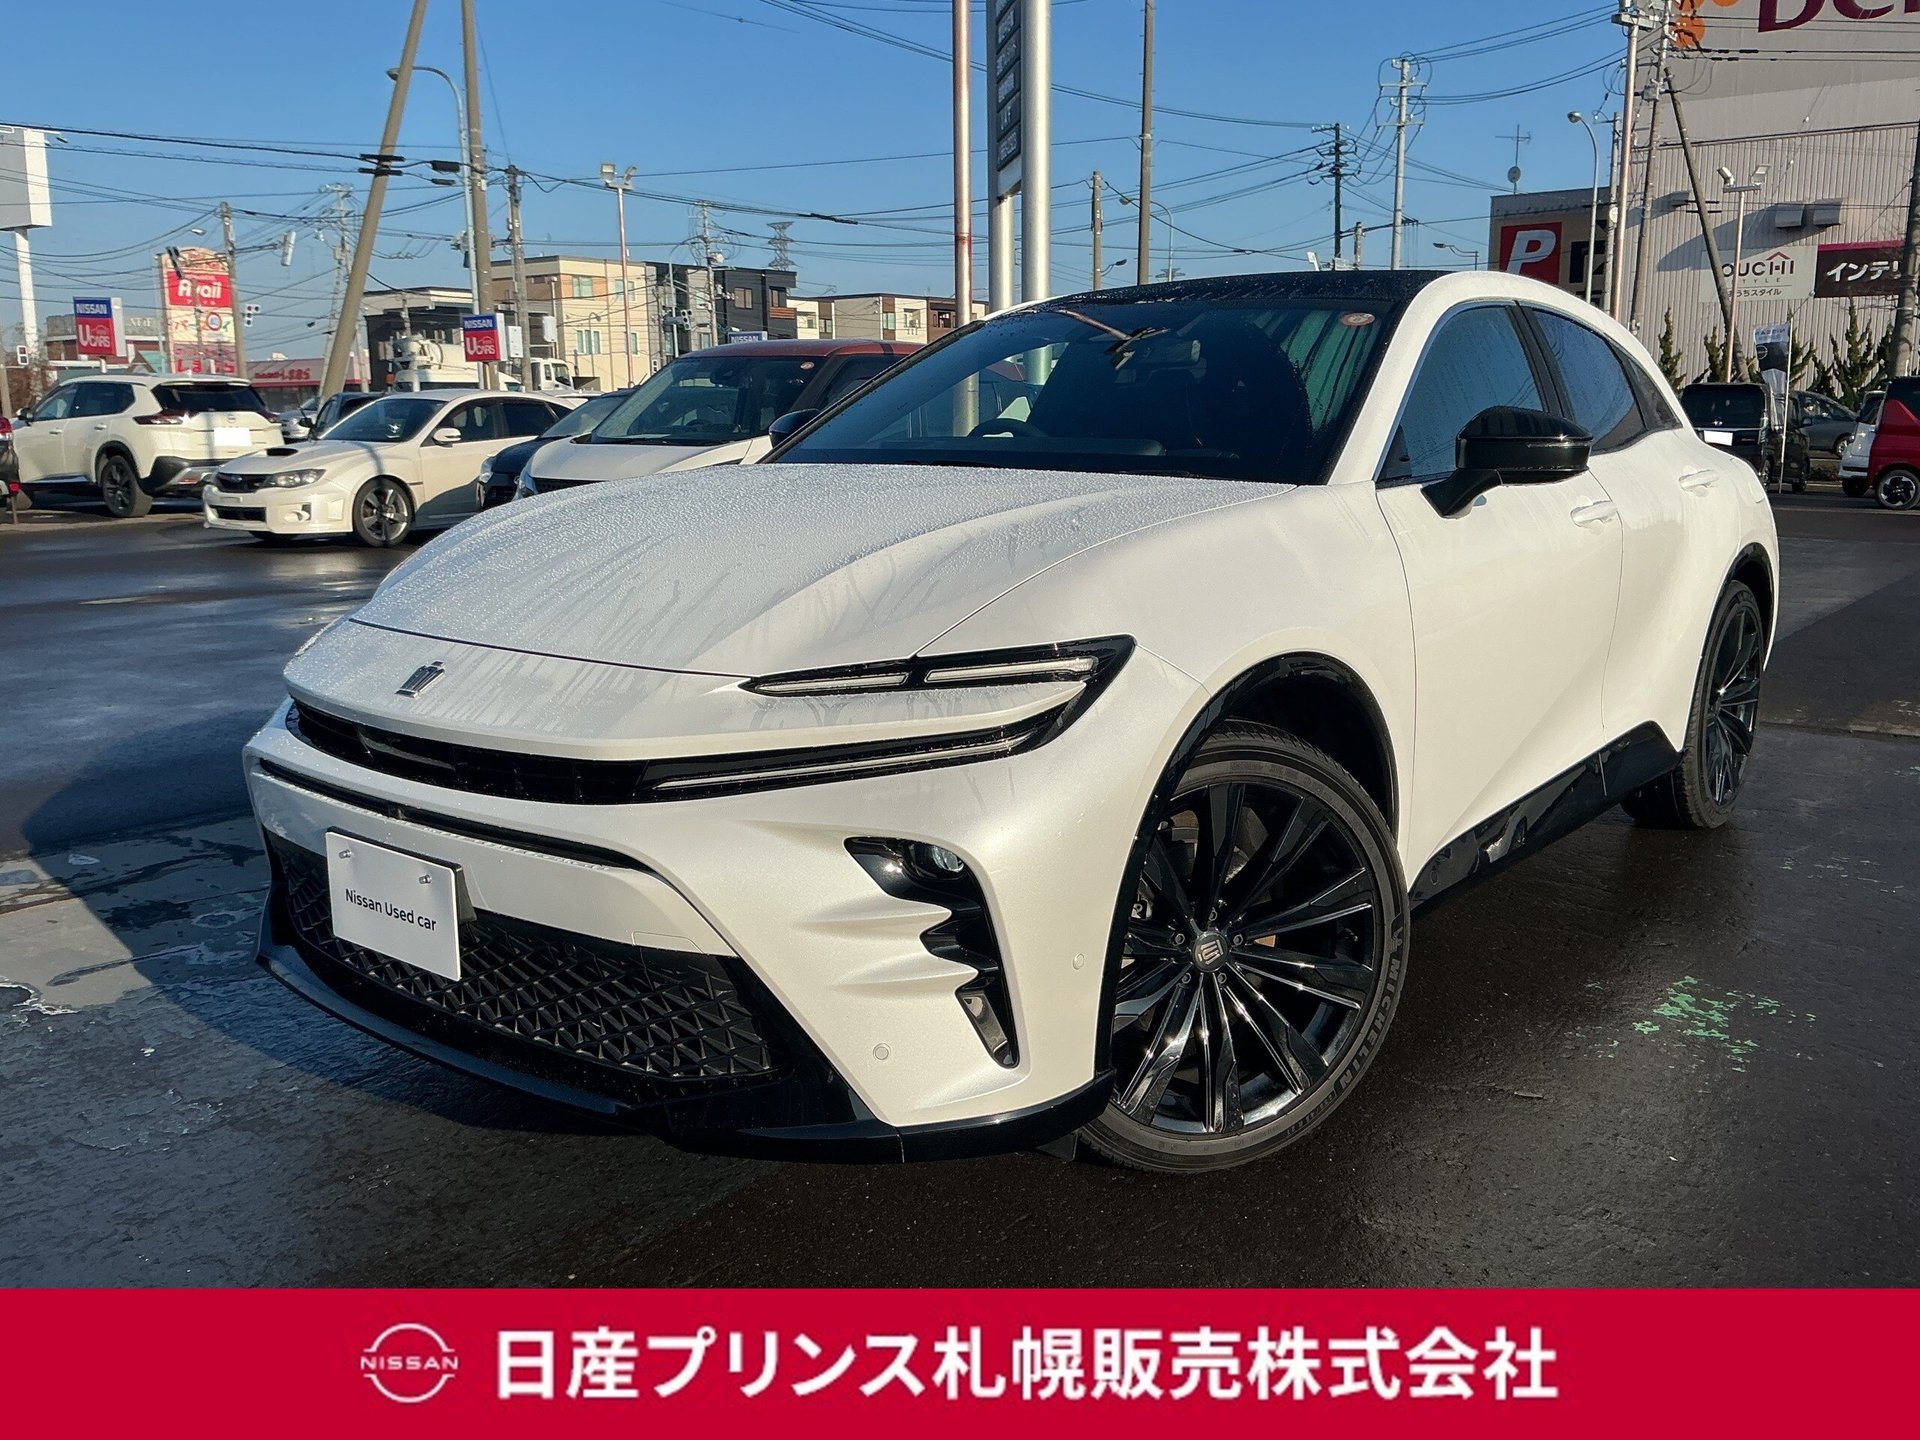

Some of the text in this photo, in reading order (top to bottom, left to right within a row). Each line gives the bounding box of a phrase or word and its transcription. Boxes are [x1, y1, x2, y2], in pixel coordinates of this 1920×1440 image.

[1506, 229, 1557, 275] P
[1722, 259, 1795, 279] OUCHI
[76, 303, 108, 315] NISSAN
[464, 319, 493, 329] NISSAN
[345, 888, 437, 931] Nissan Used car
[1336, 958, 1402, 1089] MICHELIN
